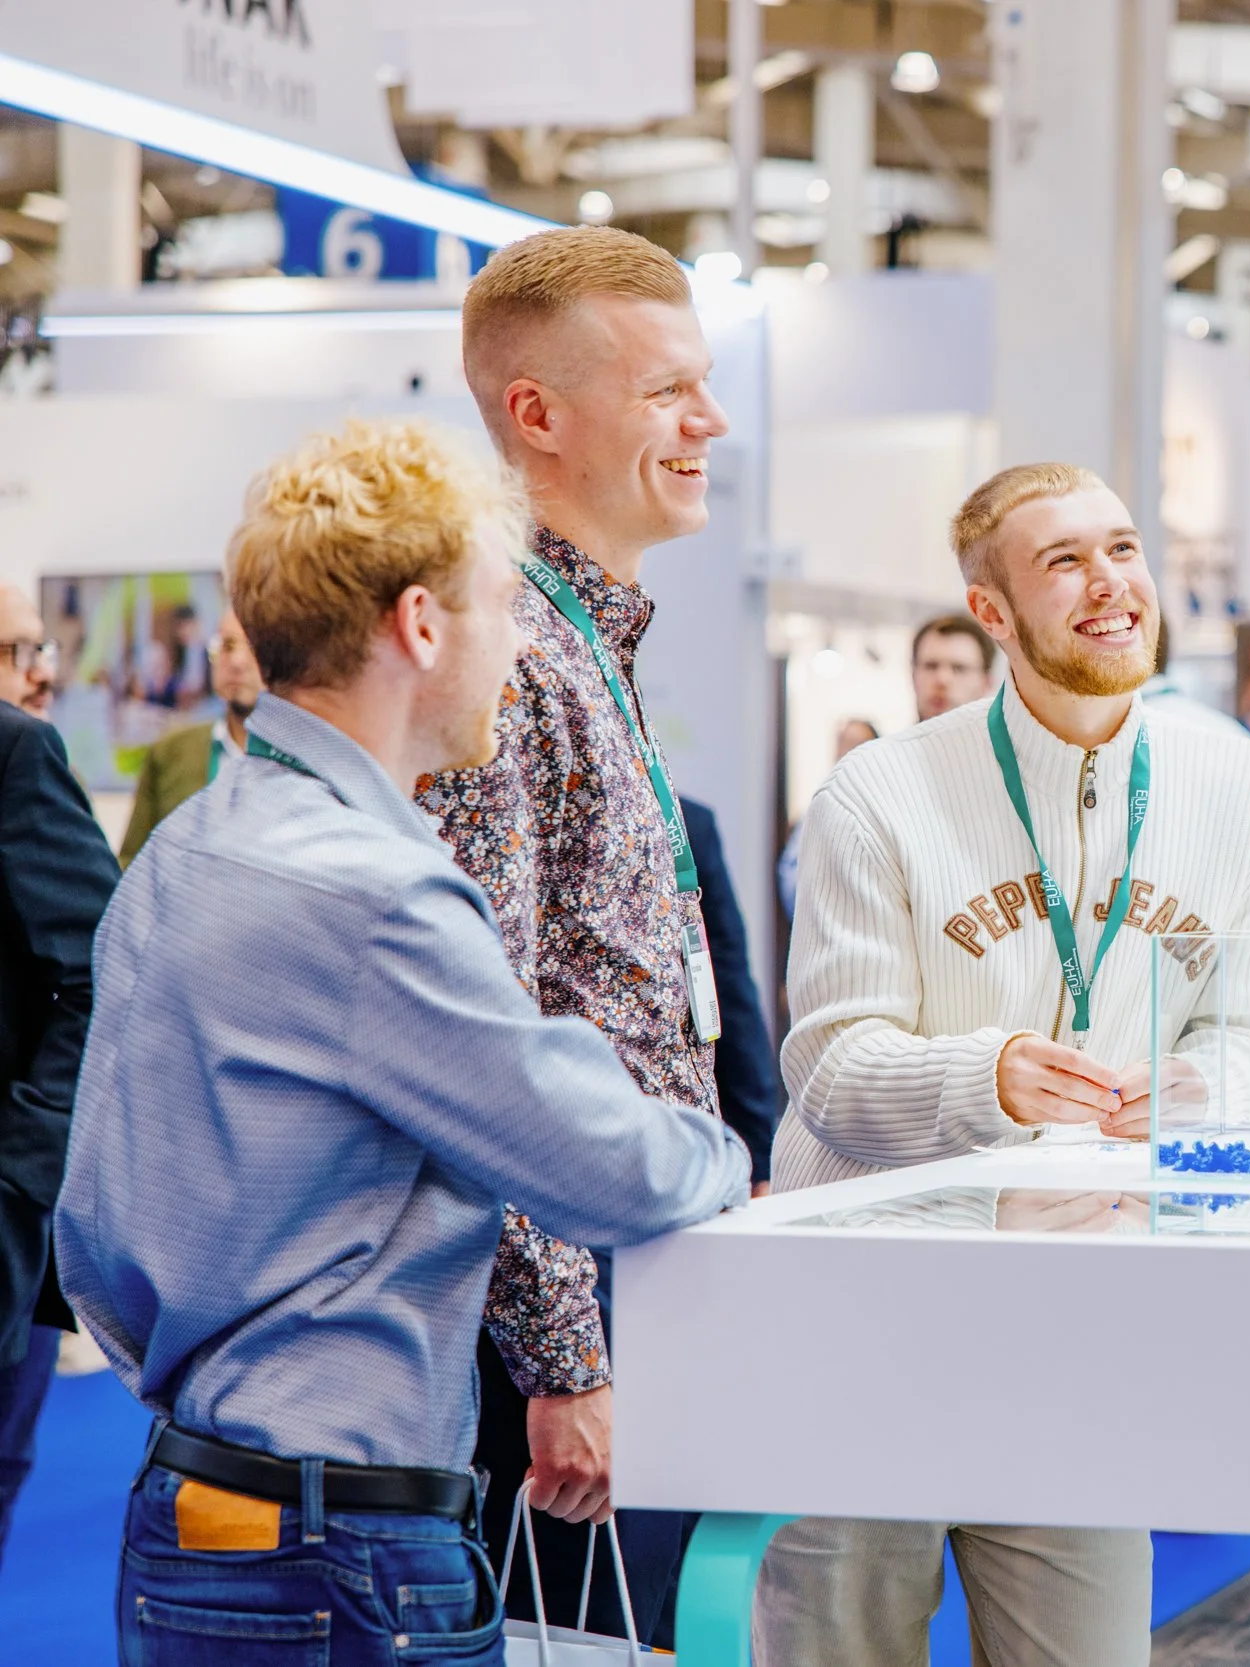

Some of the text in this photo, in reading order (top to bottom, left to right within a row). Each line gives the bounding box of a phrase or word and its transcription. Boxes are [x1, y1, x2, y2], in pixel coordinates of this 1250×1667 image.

[524, 562, 561, 596] EUHA
[1134, 788, 1149, 825] EUHA
[667, 817, 684, 858] EUHA
[1042, 869, 1061, 907] EUHA
[1063, 957, 1082, 996] EUHA
